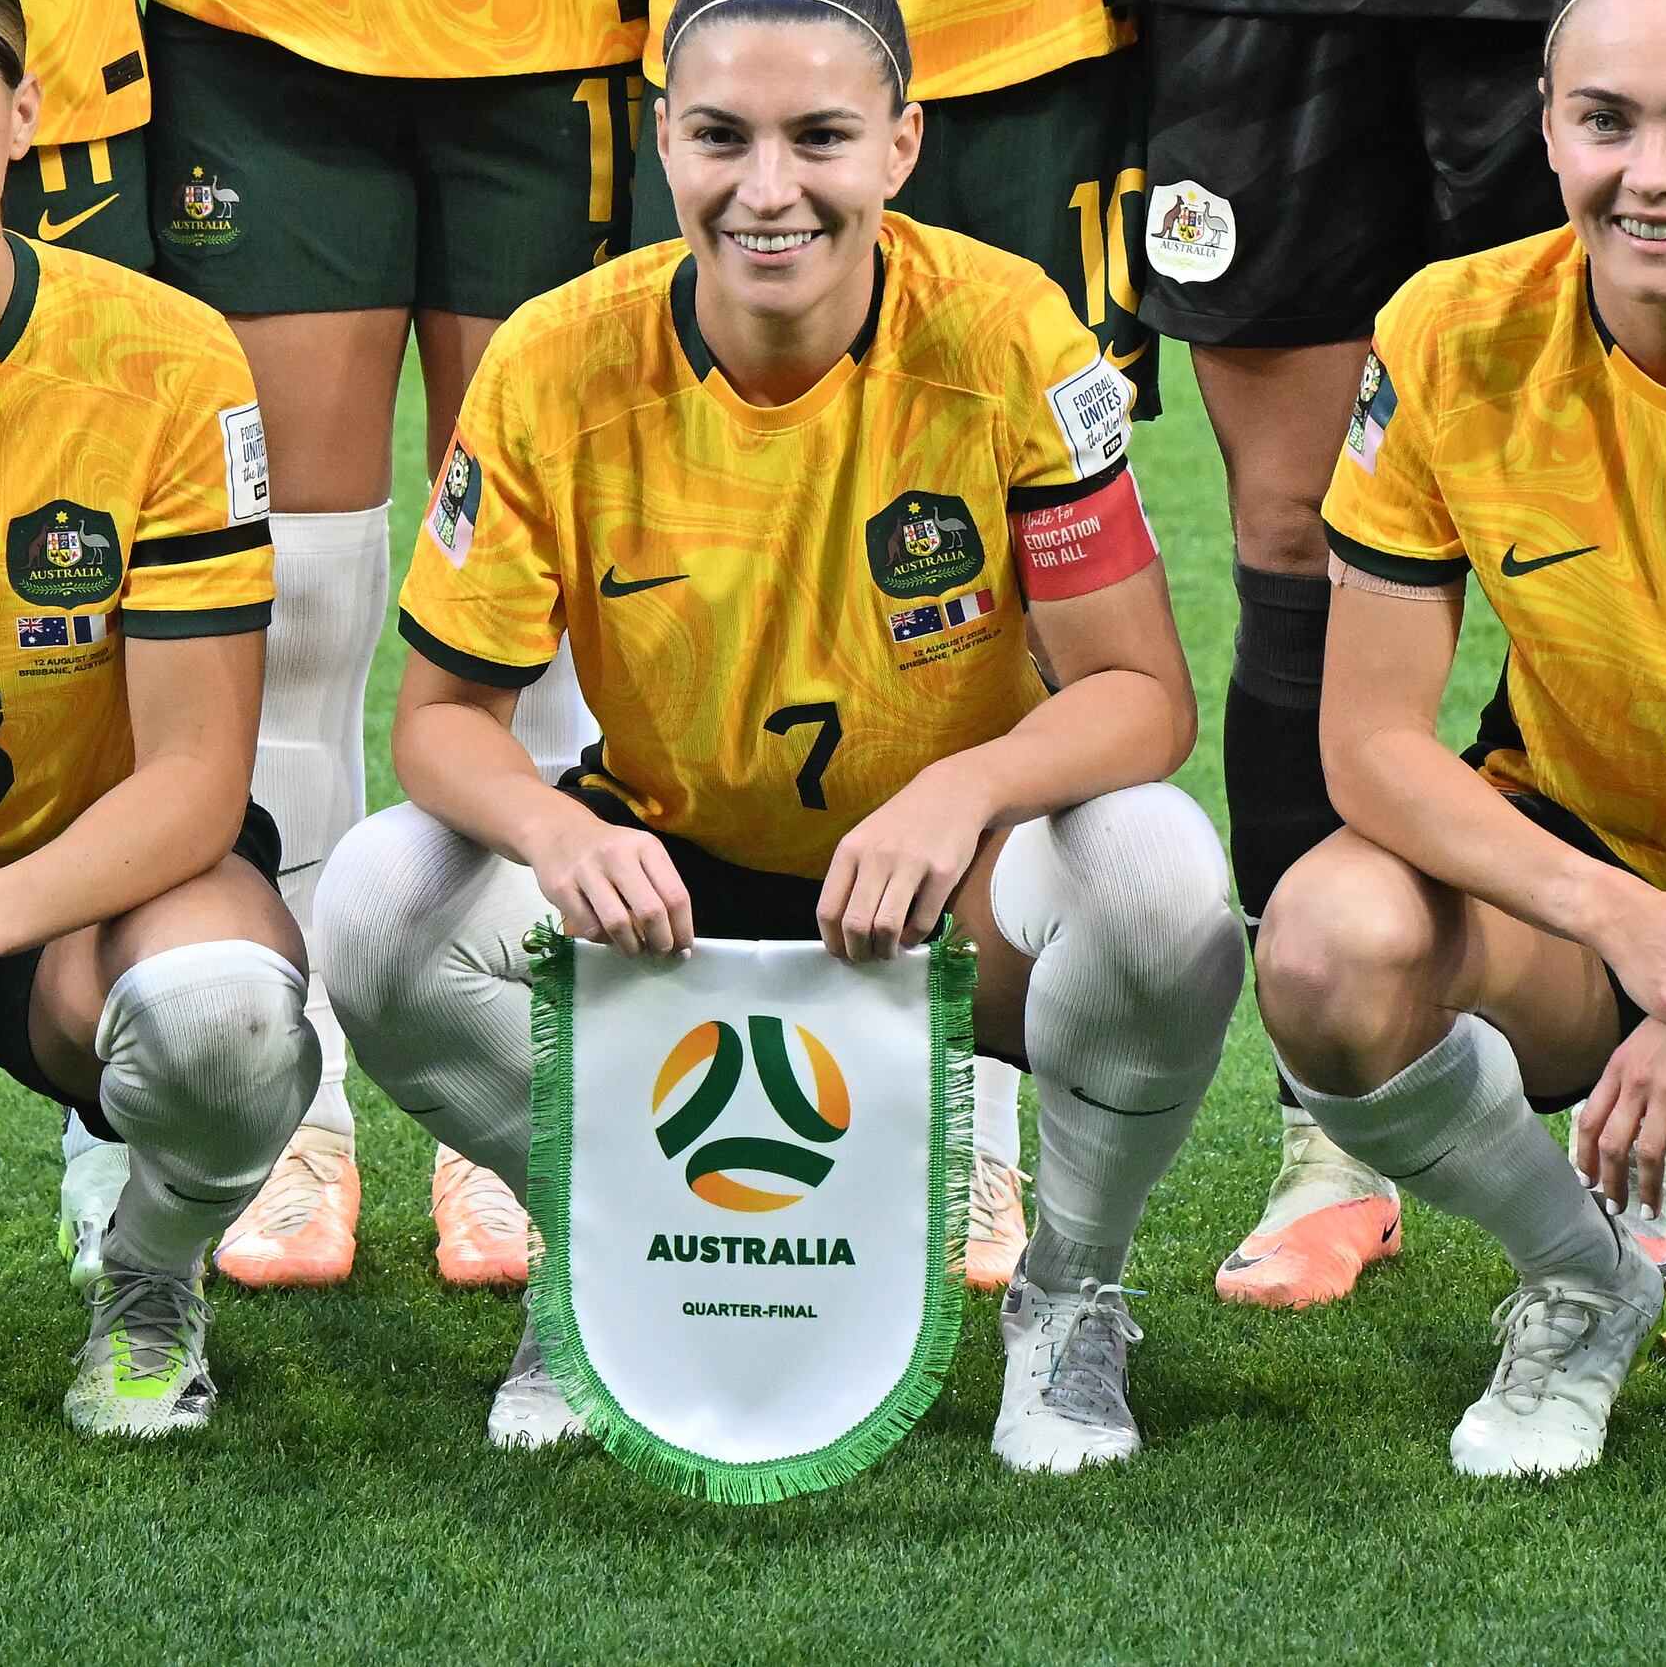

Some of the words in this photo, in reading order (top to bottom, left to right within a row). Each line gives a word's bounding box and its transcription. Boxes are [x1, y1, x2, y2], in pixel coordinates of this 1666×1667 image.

[170, 219, 232, 231] AUSTRALIA
[1160, 240, 1217, 259] AUSTRALIA
[1073, 373, 1115, 411] FOOTBALL
[1079, 388, 1121, 430] UNITES
[1085, 429, 1104, 450] the
[1105, 438, 1121, 456] FIFA
[1022, 512, 1054, 530] Unite
[1053, 503, 1075, 525] For
[1024, 515, 1102, 551] EDUCATION
[893, 549, 966, 576] AUSTRALIA
[1031, 549, 1059, 569] FOR
[1060, 543, 1088, 562] ALL
[29, 567, 103, 580] AUSTRALIA
[913, 649, 924, 657] 12
[925, 636, 965, 655] AUGUST
[34, 658, 45, 666] 12
[46, 655, 87, 667] AUGUST
[763, 701, 843, 811] 7
[645, 1233, 857, 1267] AUSTRALIA
[681, 1301, 819, 1320] QUARTER-FINAL
